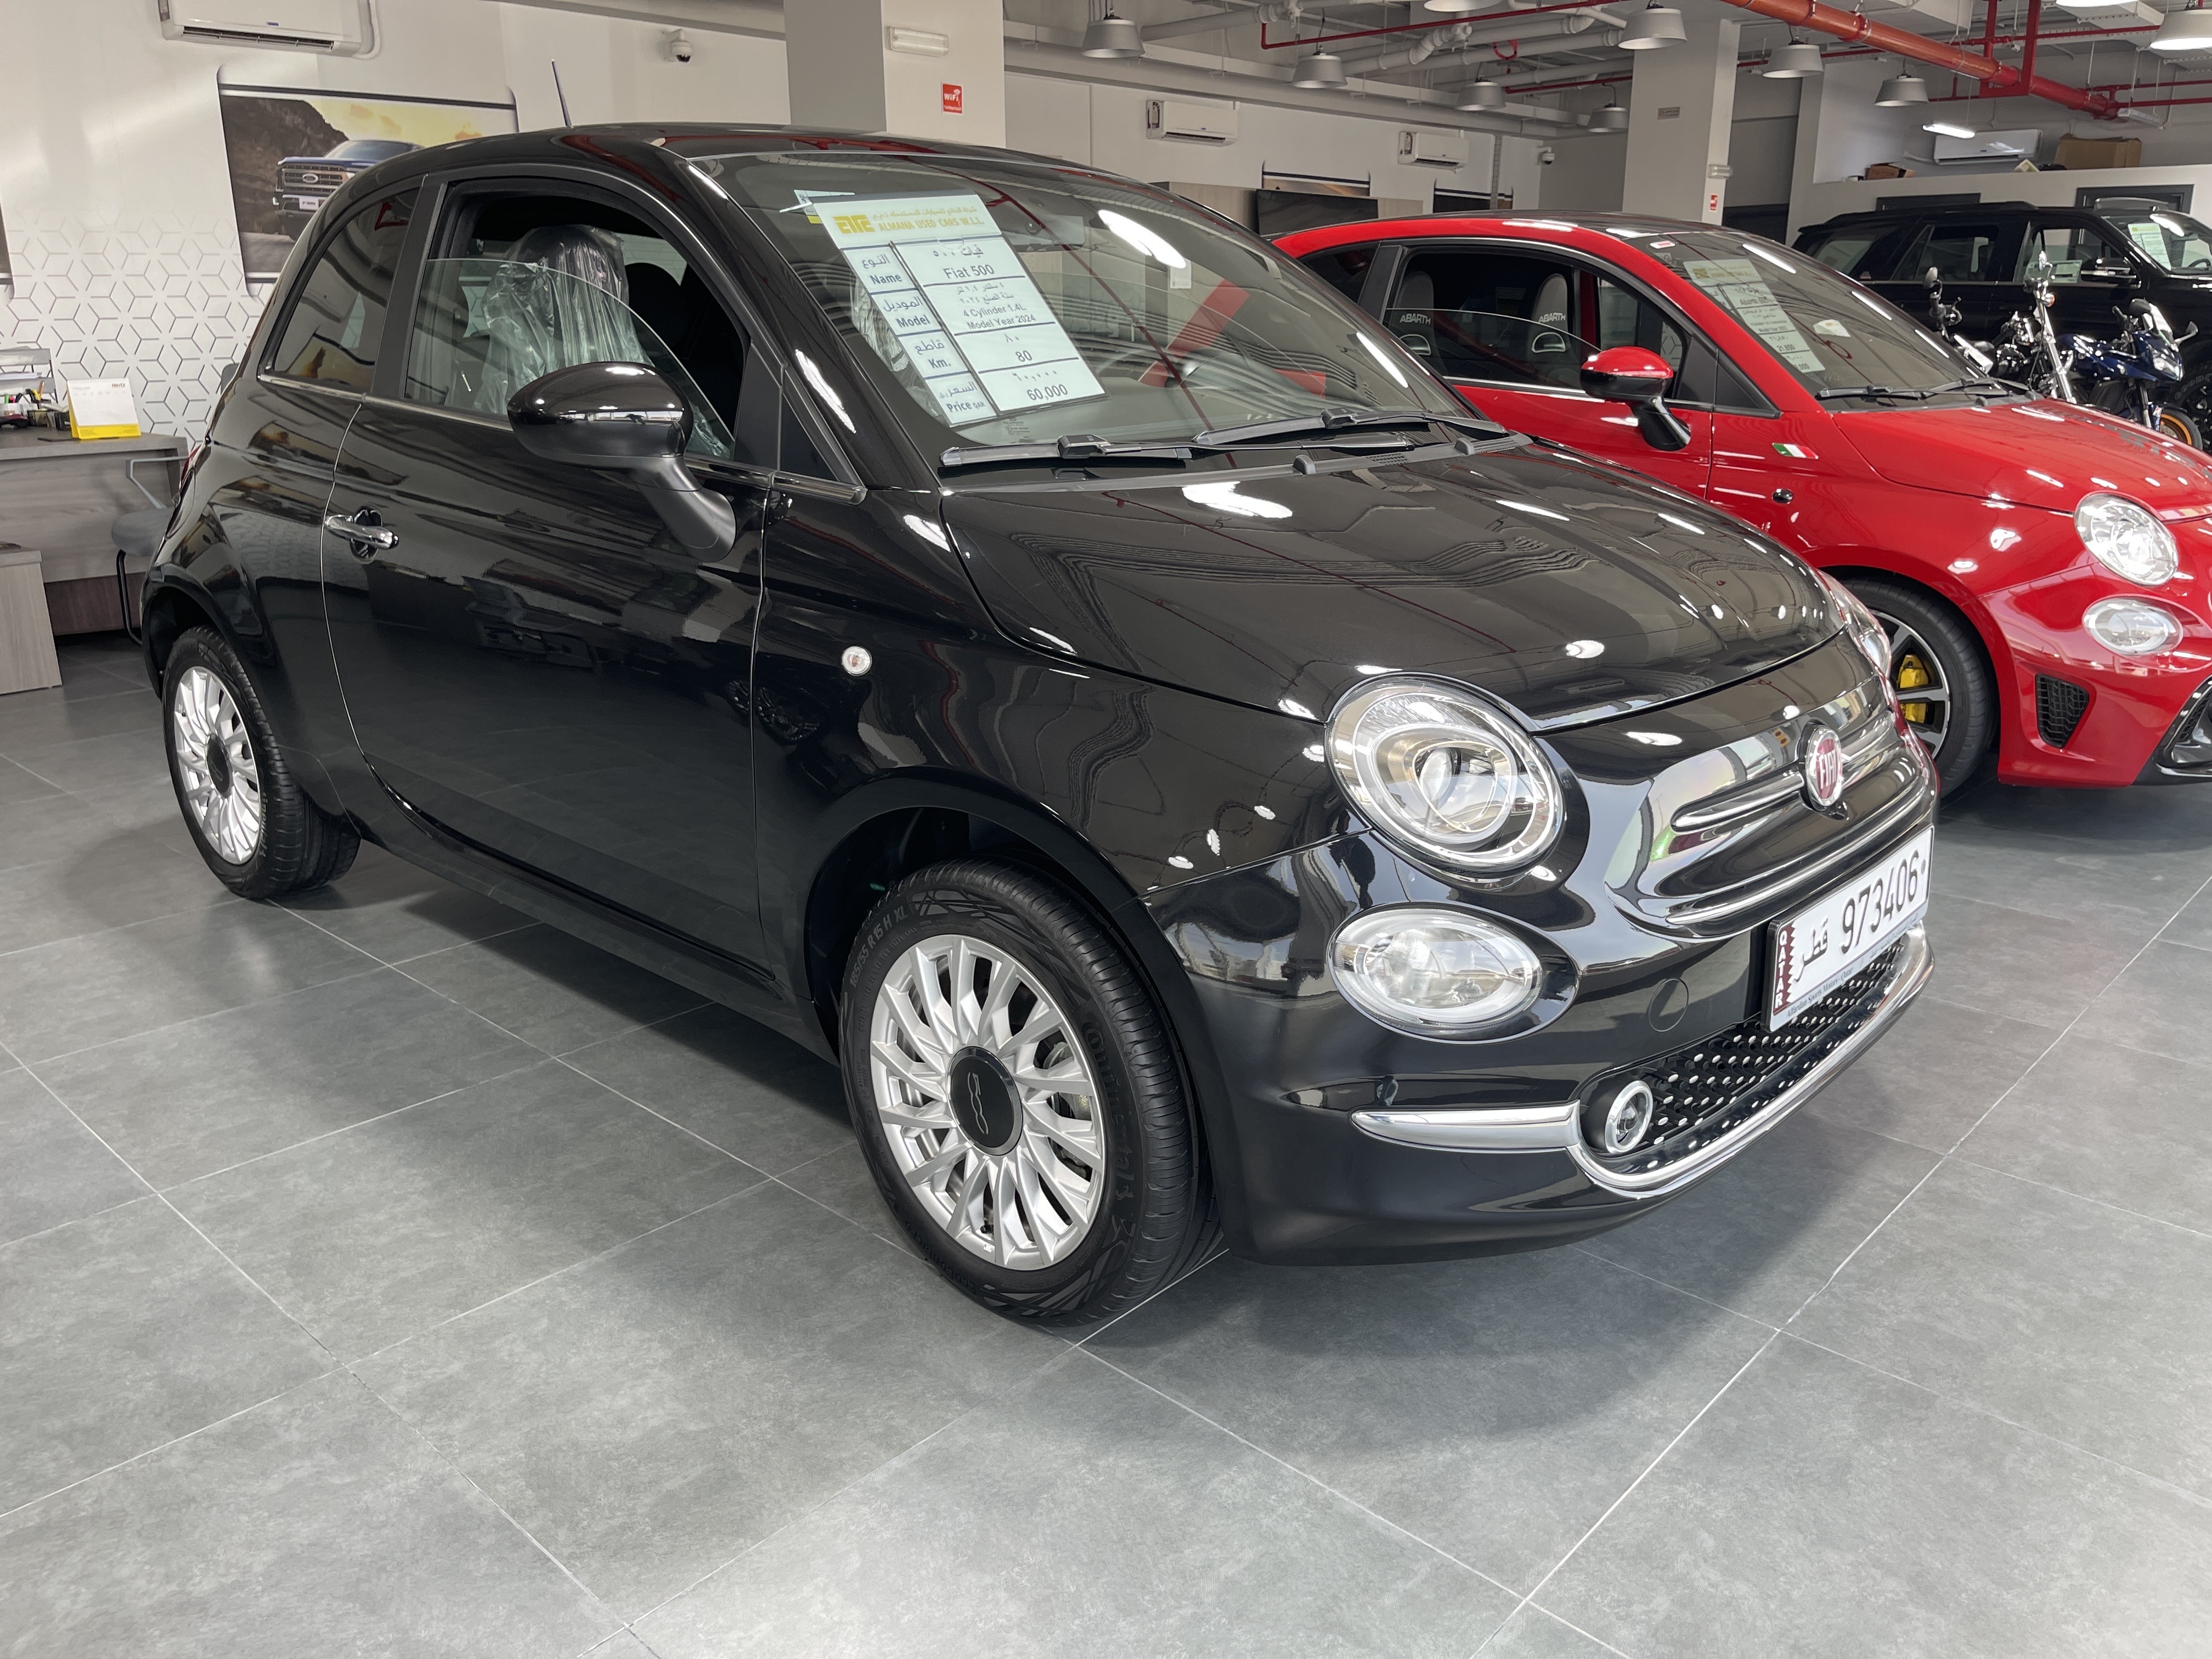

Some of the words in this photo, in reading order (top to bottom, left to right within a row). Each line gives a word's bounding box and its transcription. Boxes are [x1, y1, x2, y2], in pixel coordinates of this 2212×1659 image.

[878, 221, 915, 232] ALMANA
[915, 219, 936, 229] USED
[939, 218, 960, 227] CARS
[961, 217, 985, 225] W.L.L.
[960, 244, 984, 258] فيات
[861, 253, 891, 269] النوع
[943, 267, 971, 279] Fiat
[971, 264, 995, 276] 500
[869, 274, 902, 285] Name
[883, 296, 923, 312] الموديل
[963, 309, 969, 318] 4
[970, 306, 1006, 318] Cylinder
[1007, 303, 1026, 313] 1.4L
[895, 314, 930, 328] Model
[966, 319, 995, 330] Model
[994, 317, 1015, 325] Year
[1015, 314, 1036, 323] 2024
[1399, 313, 1431, 325] ABARTH
[1538, 312, 1566, 323] ABARTH
[915, 340, 945, 355] قاطع
[1015, 350, 1032, 362] 80
[928, 359, 951, 369] Km.
[947, 381, 978, 397] السعر
[1026, 383, 1068, 400] 60,000
[946, 401, 972, 413] Price
[973, 401, 986, 410] QAR
[1839, 849, 1920, 955] 973406
[850, 944, 870, 988] 185/55
[867, 934, 877, 949] R
[873, 923, 884, 941] 15
[883, 913, 893, 931] H
[894, 906, 909, 923] XL
[1793, 915, 1829, 983] قطر
[1774, 930, 1788, 1009] QATAR
